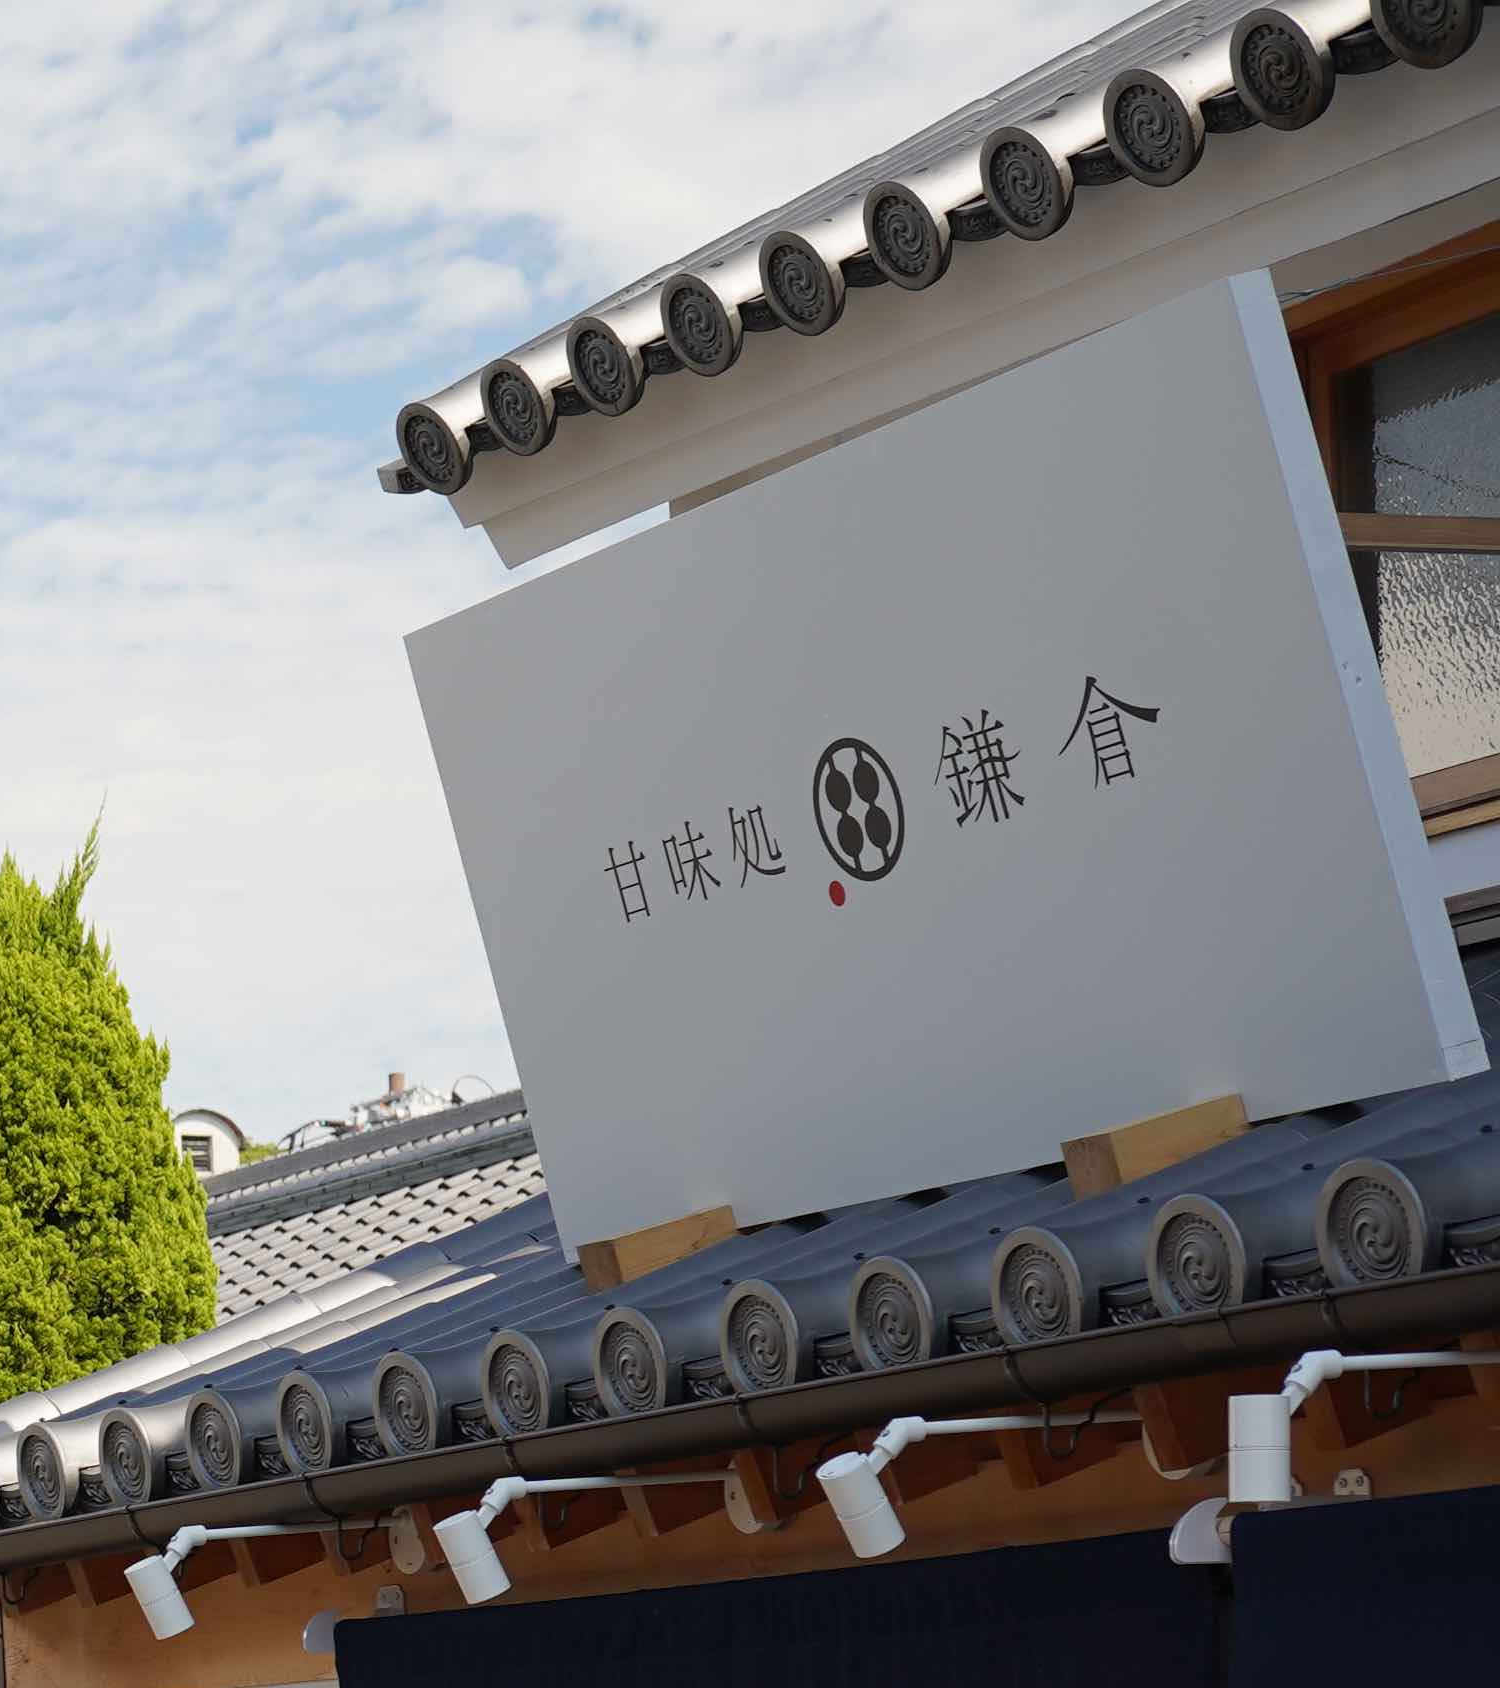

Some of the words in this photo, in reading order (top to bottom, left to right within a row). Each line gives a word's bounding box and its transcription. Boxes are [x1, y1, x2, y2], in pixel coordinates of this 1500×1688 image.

[603, 803, 788, 924] 甘味処
[933, 675, 1161, 828] 鎌倉
